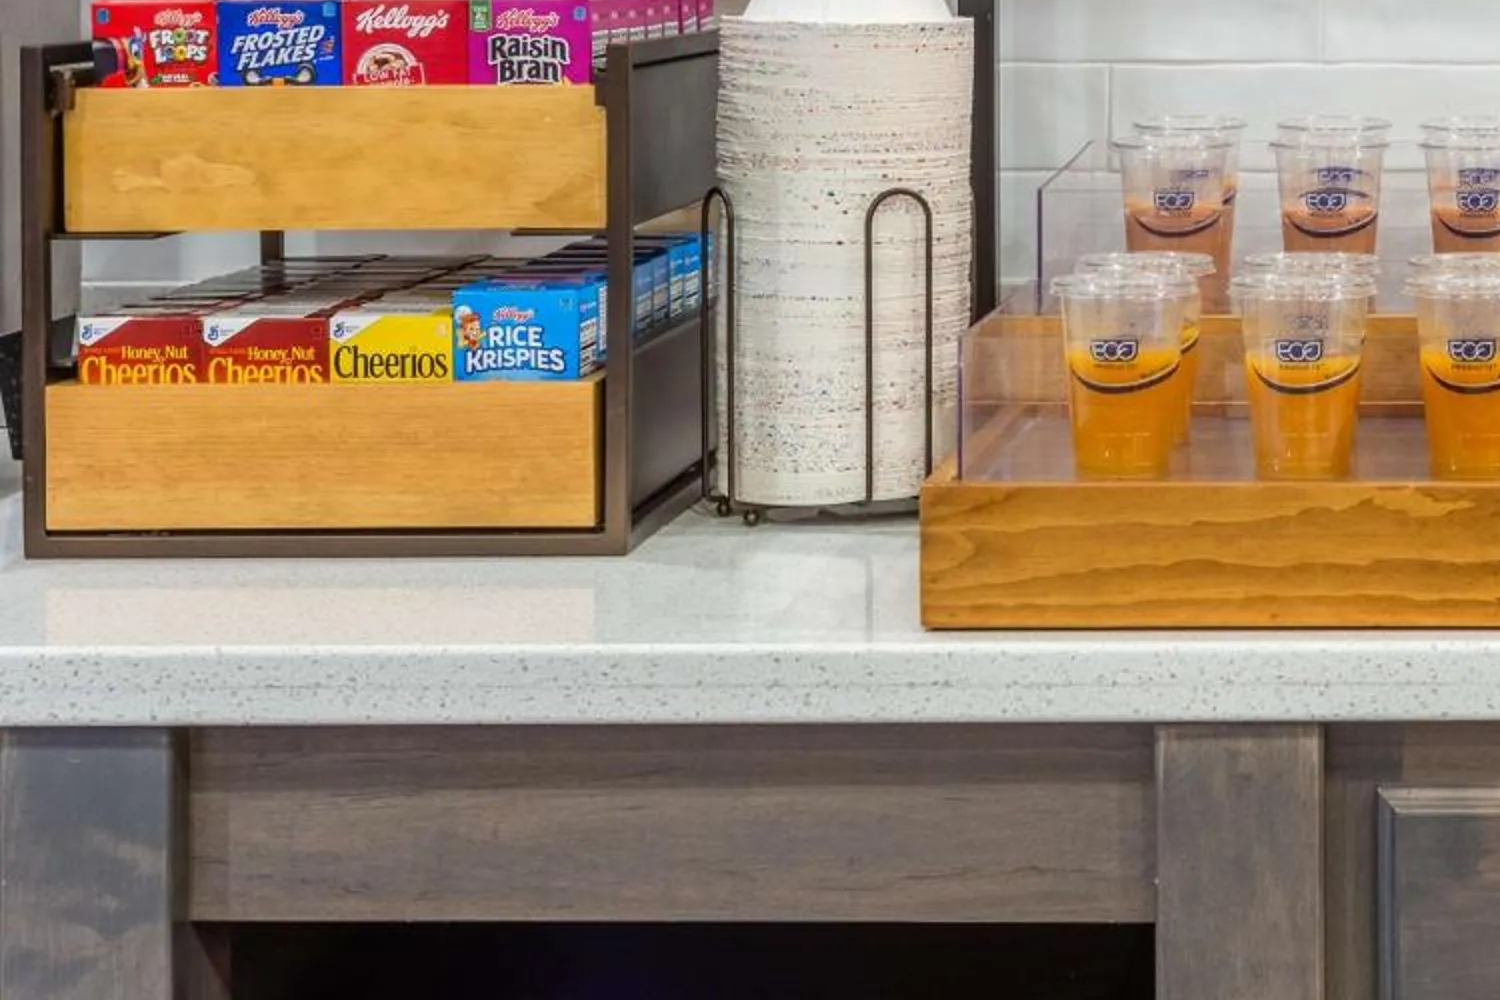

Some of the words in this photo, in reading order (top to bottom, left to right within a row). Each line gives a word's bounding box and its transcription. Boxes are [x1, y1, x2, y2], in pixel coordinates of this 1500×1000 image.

[356, 4, 451, 38] Kellogg's
[149, 27, 209, 49] FROOT
[230, 25, 325, 55] FROSTED
[490, 34, 568, 62] Raisin
[154, 44, 208, 65] LOOPS
[236, 43, 317, 71] FLAKES
[499, 59, 560, 83] Bran
[488, 325, 543, 348] RICE
[121, 345, 161, 362] Honey
[164, 345, 189, 360] Nut
[247, 346, 289, 363] Honey
[291, 346, 316, 361] Nut
[333, 345, 449, 379] Cheerios
[465, 347, 565, 374] KRISPIES
[80, 355, 198, 384] Cheerios
[207, 356, 324, 384] Cheerios
